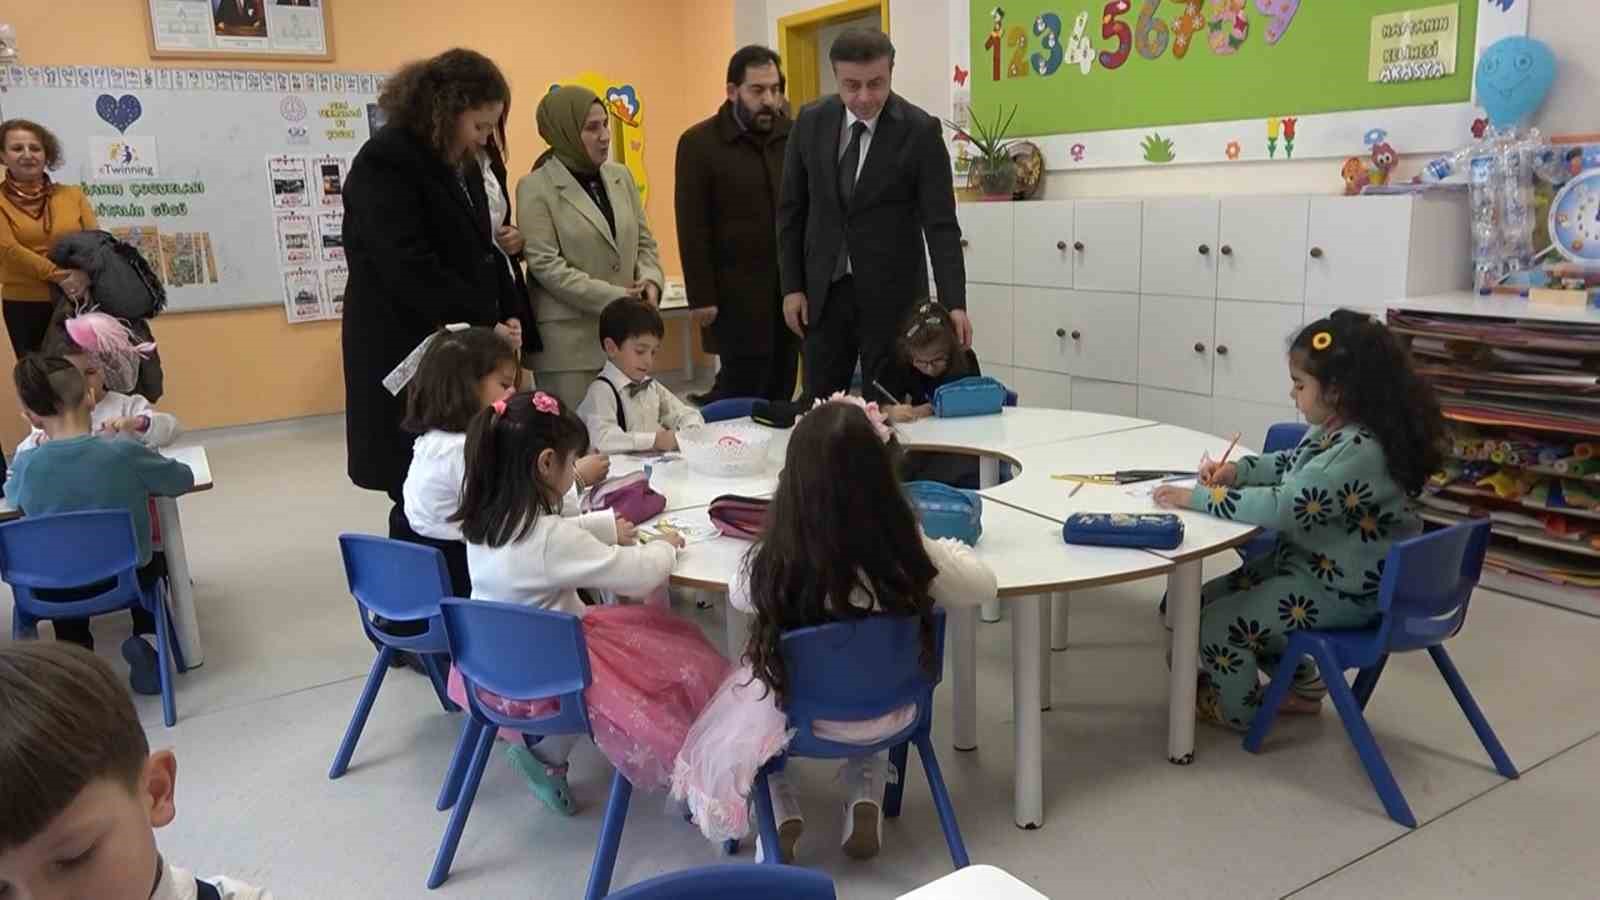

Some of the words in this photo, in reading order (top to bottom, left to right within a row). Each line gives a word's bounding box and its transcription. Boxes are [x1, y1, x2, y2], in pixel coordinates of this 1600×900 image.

[1382, 16, 1449, 39] HAFTANIN
[1007, 25, 1029, 79] 2
[1030, 13, 1063, 76] 3
[1064, 10, 1096, 75] 4
[1099, 0, 1132, 70] 5
[1135, 0, 1169, 60] 6
[1169, 0, 1205, 58] 7
[1377, 61, 1446, 82] AKASYA
[99, 164, 154, 176] eTwinning
